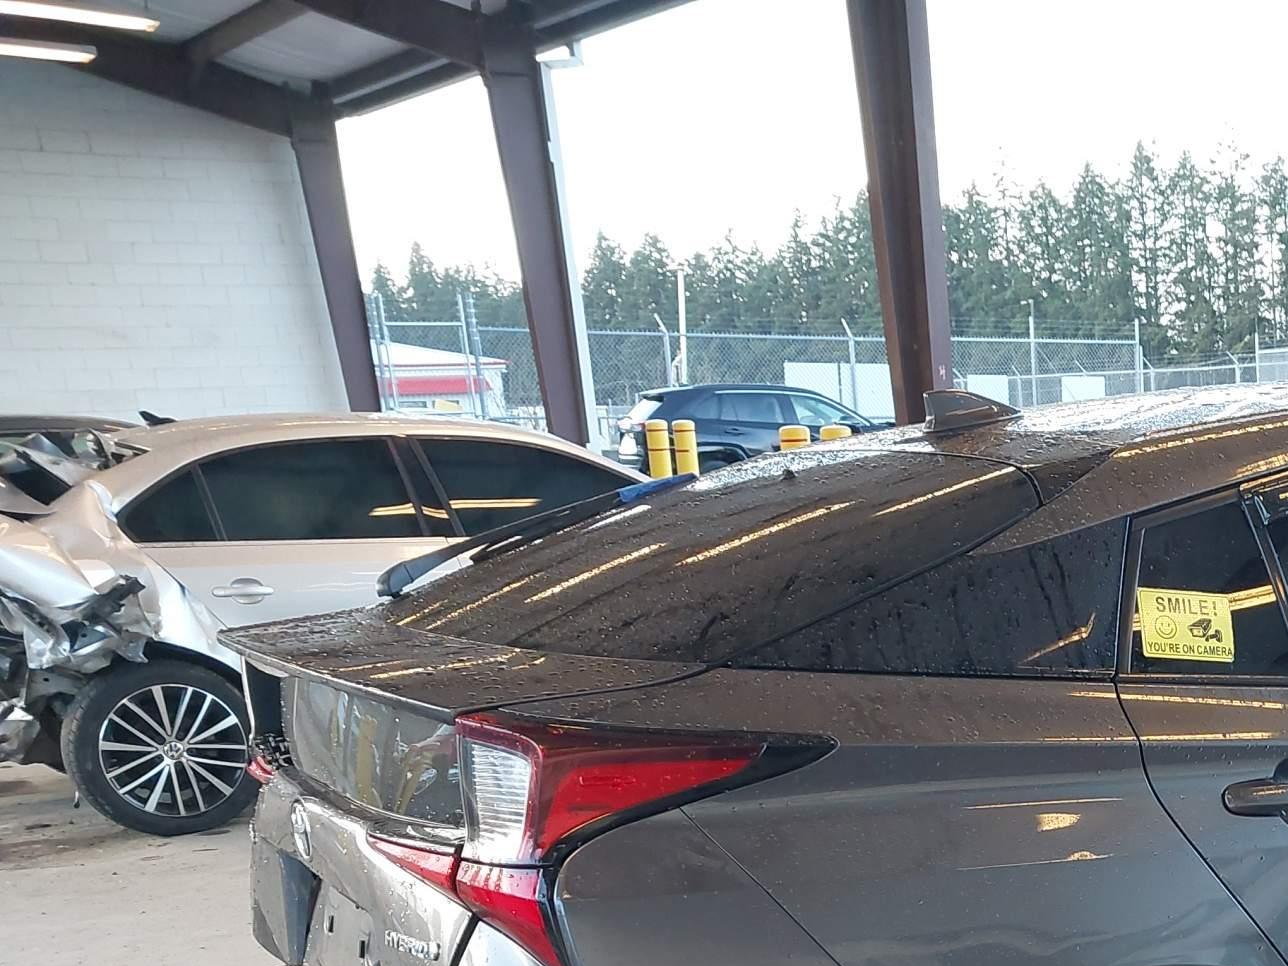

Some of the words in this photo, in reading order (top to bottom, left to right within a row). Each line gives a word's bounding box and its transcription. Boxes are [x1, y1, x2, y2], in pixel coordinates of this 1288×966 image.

[1155, 596, 1218, 616] SMILE!
[1147, 641, 1180, 655] YOU'RE
[1182, 644, 1195, 655] ON
[1197, 645, 1233, 657] CAMERA
